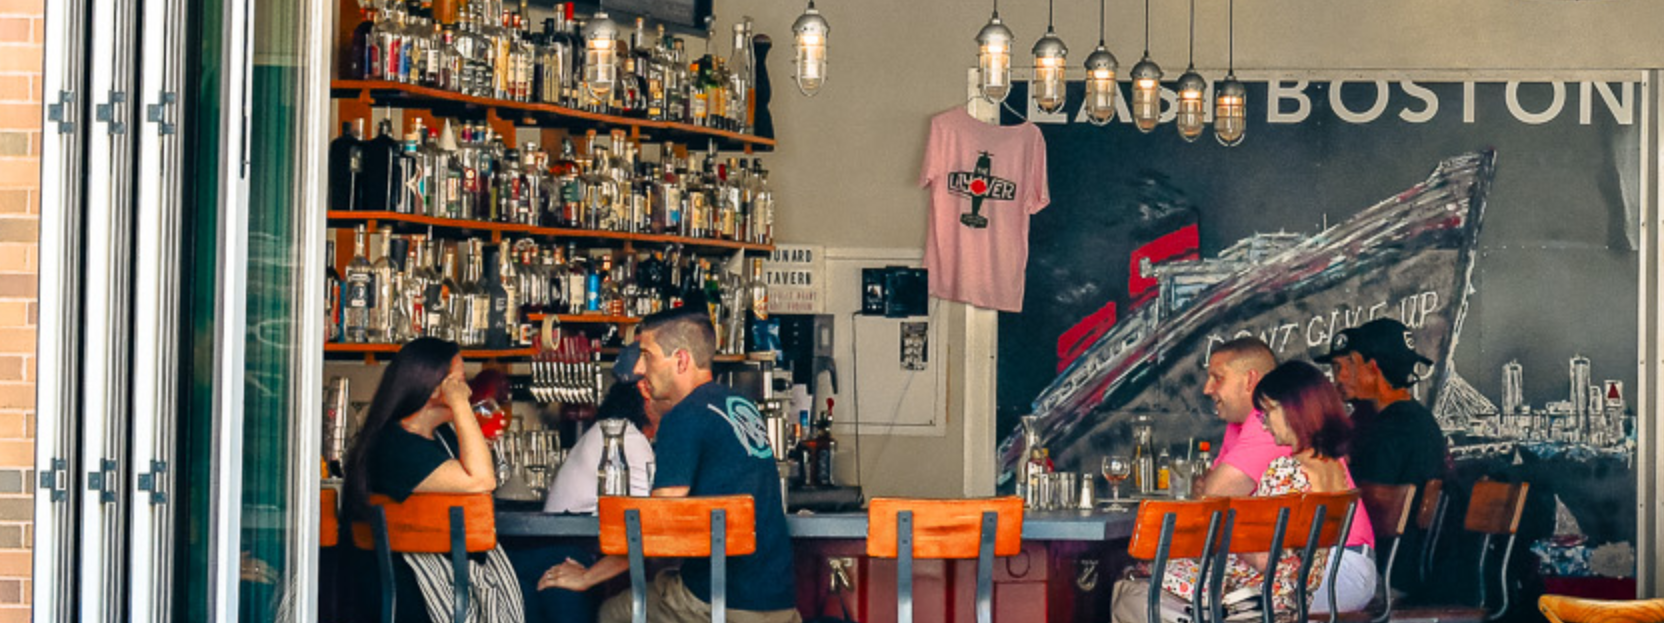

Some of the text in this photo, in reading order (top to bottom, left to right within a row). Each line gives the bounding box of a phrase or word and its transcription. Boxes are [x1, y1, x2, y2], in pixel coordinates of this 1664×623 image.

[1267, 81, 1634, 124] BOSTON
[766, 271, 812, 285] TAVERN
[1203, 322, 1299, 368] DNT
[1401, 291, 1439, 329] UP
